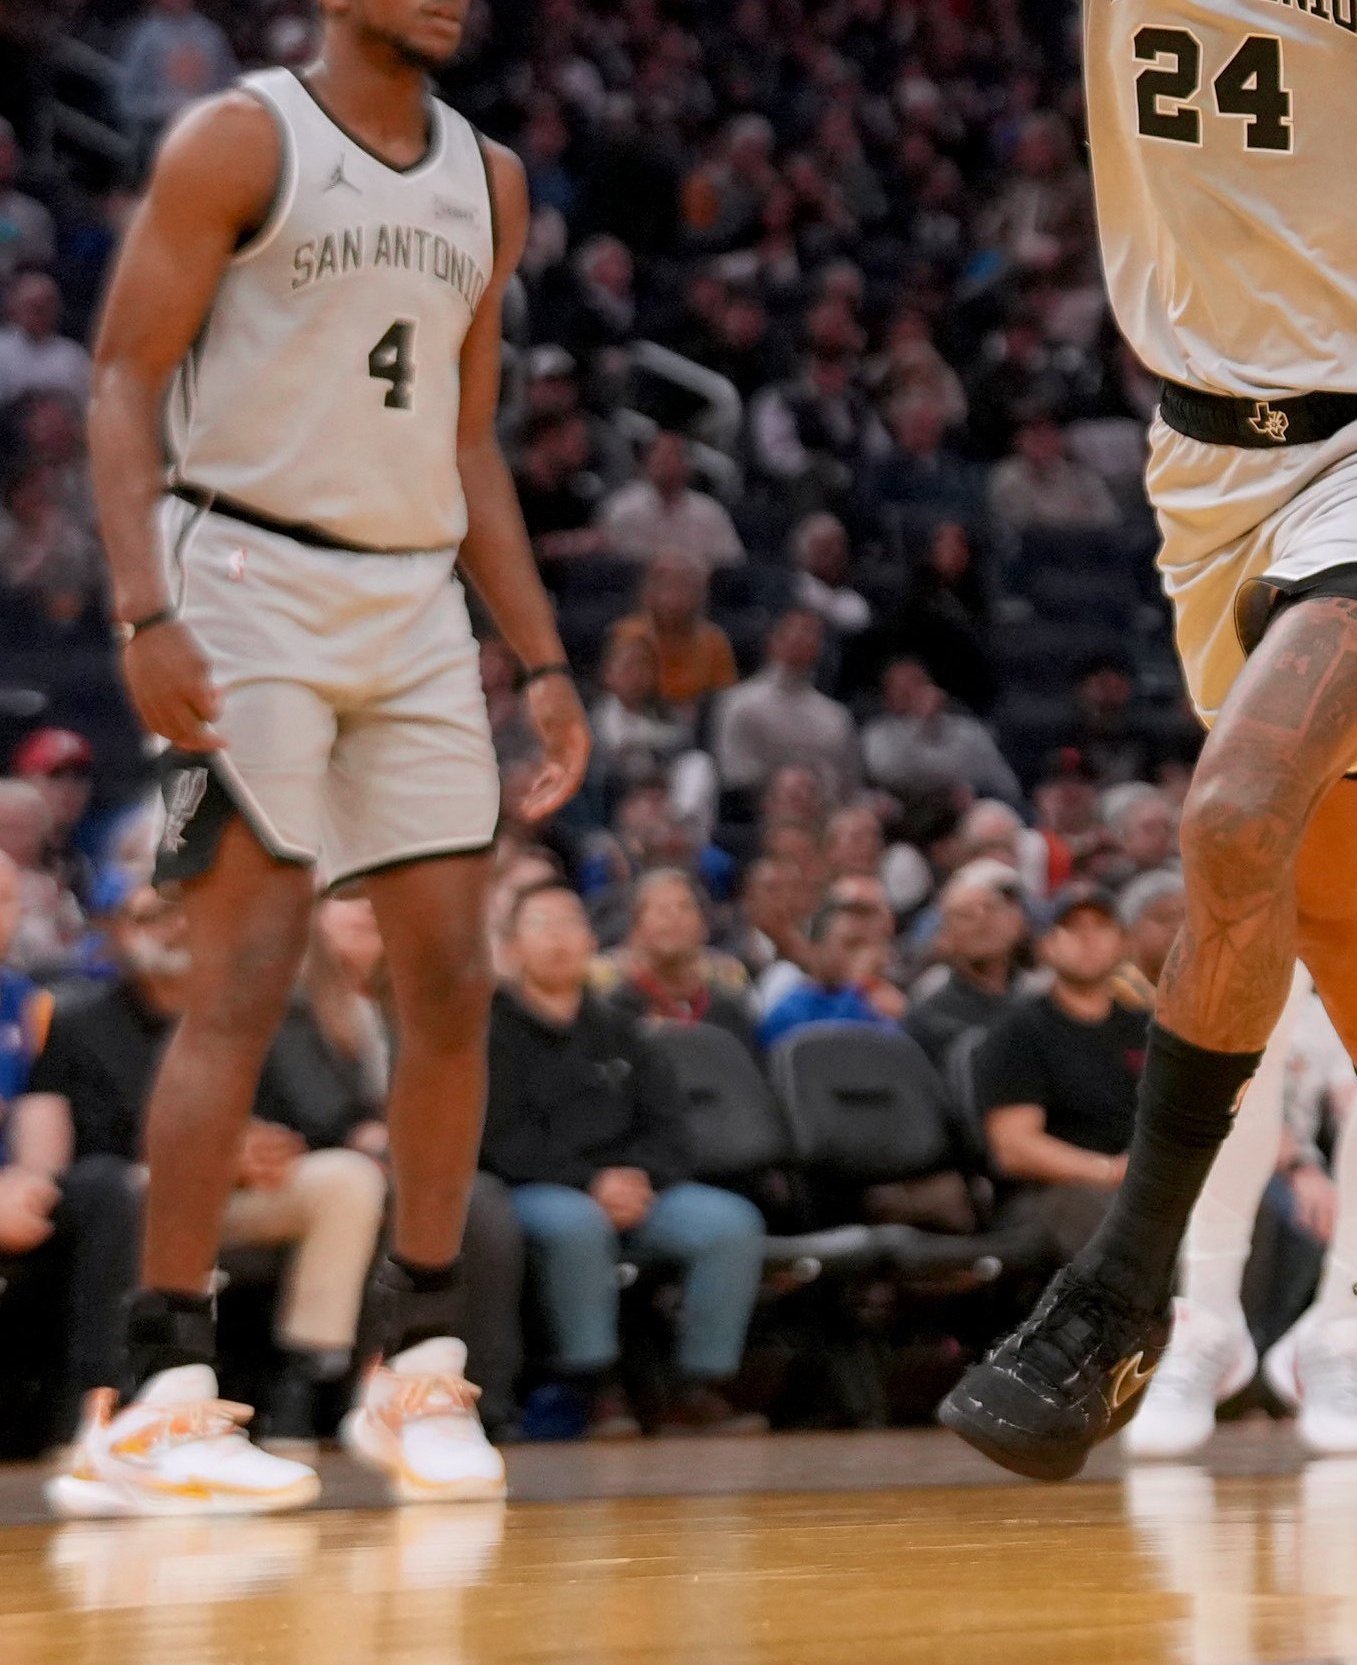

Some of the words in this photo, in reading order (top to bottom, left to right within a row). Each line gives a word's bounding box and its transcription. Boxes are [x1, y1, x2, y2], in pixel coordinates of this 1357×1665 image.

[1131, 24, 1294, 154] 24
[291, 226, 366, 291] SAN
[367, 316, 419, 411] 4
